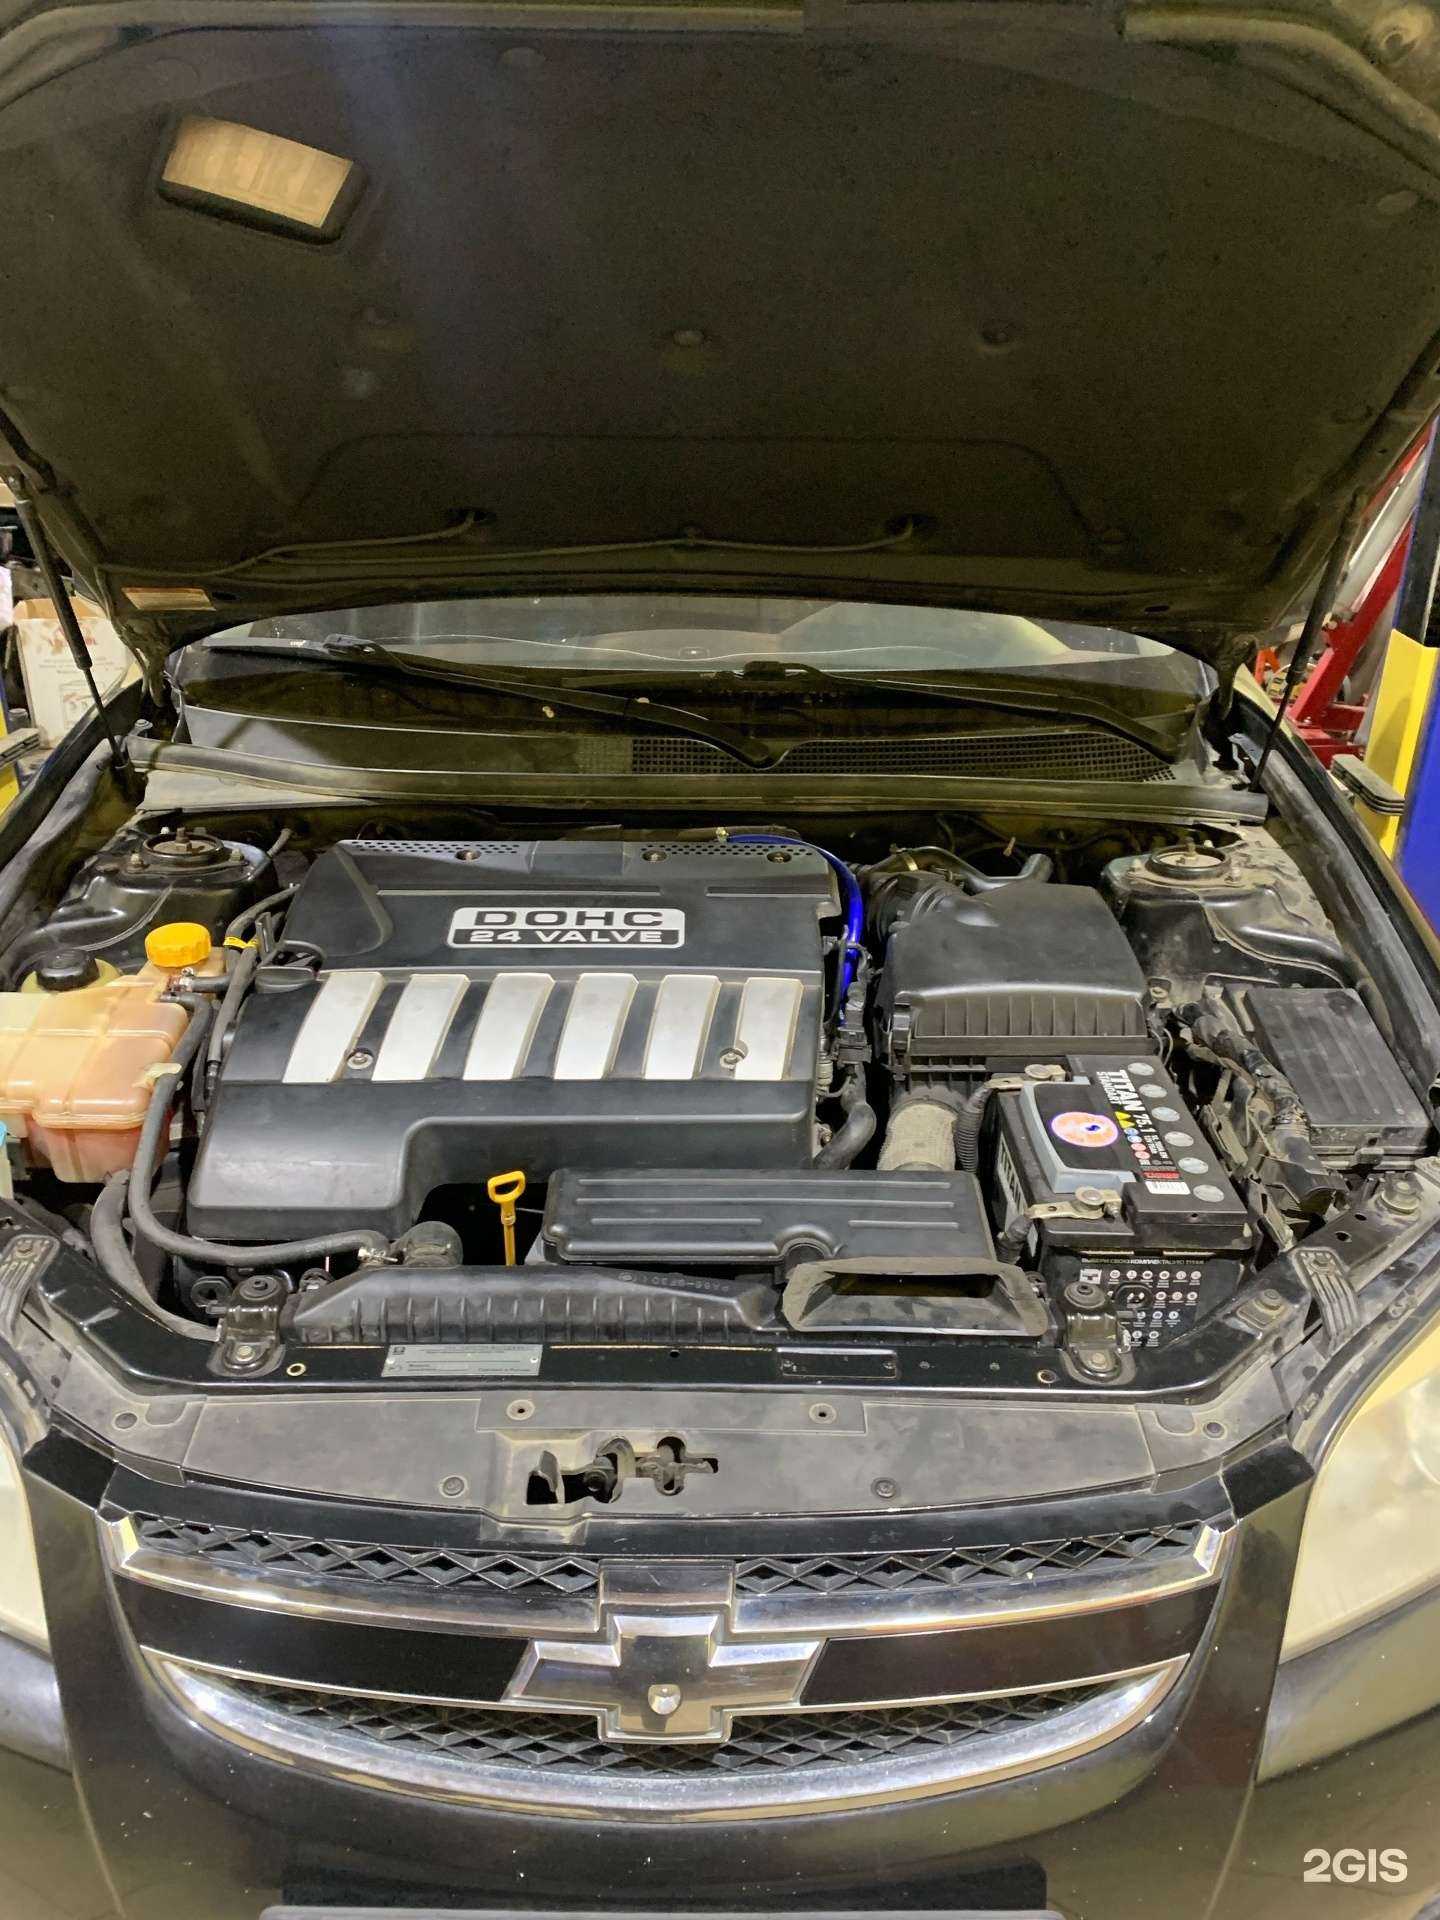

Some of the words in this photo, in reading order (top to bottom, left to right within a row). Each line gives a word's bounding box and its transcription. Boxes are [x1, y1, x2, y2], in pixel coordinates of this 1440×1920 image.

[474, 910, 663, 926] DOHC
[470, 931, 521, 943] 24
[536, 931, 662, 943] VALVE
[1096, 1071, 1122, 1105] STANDART
[1107, 1069, 1146, 1111] TITAN
